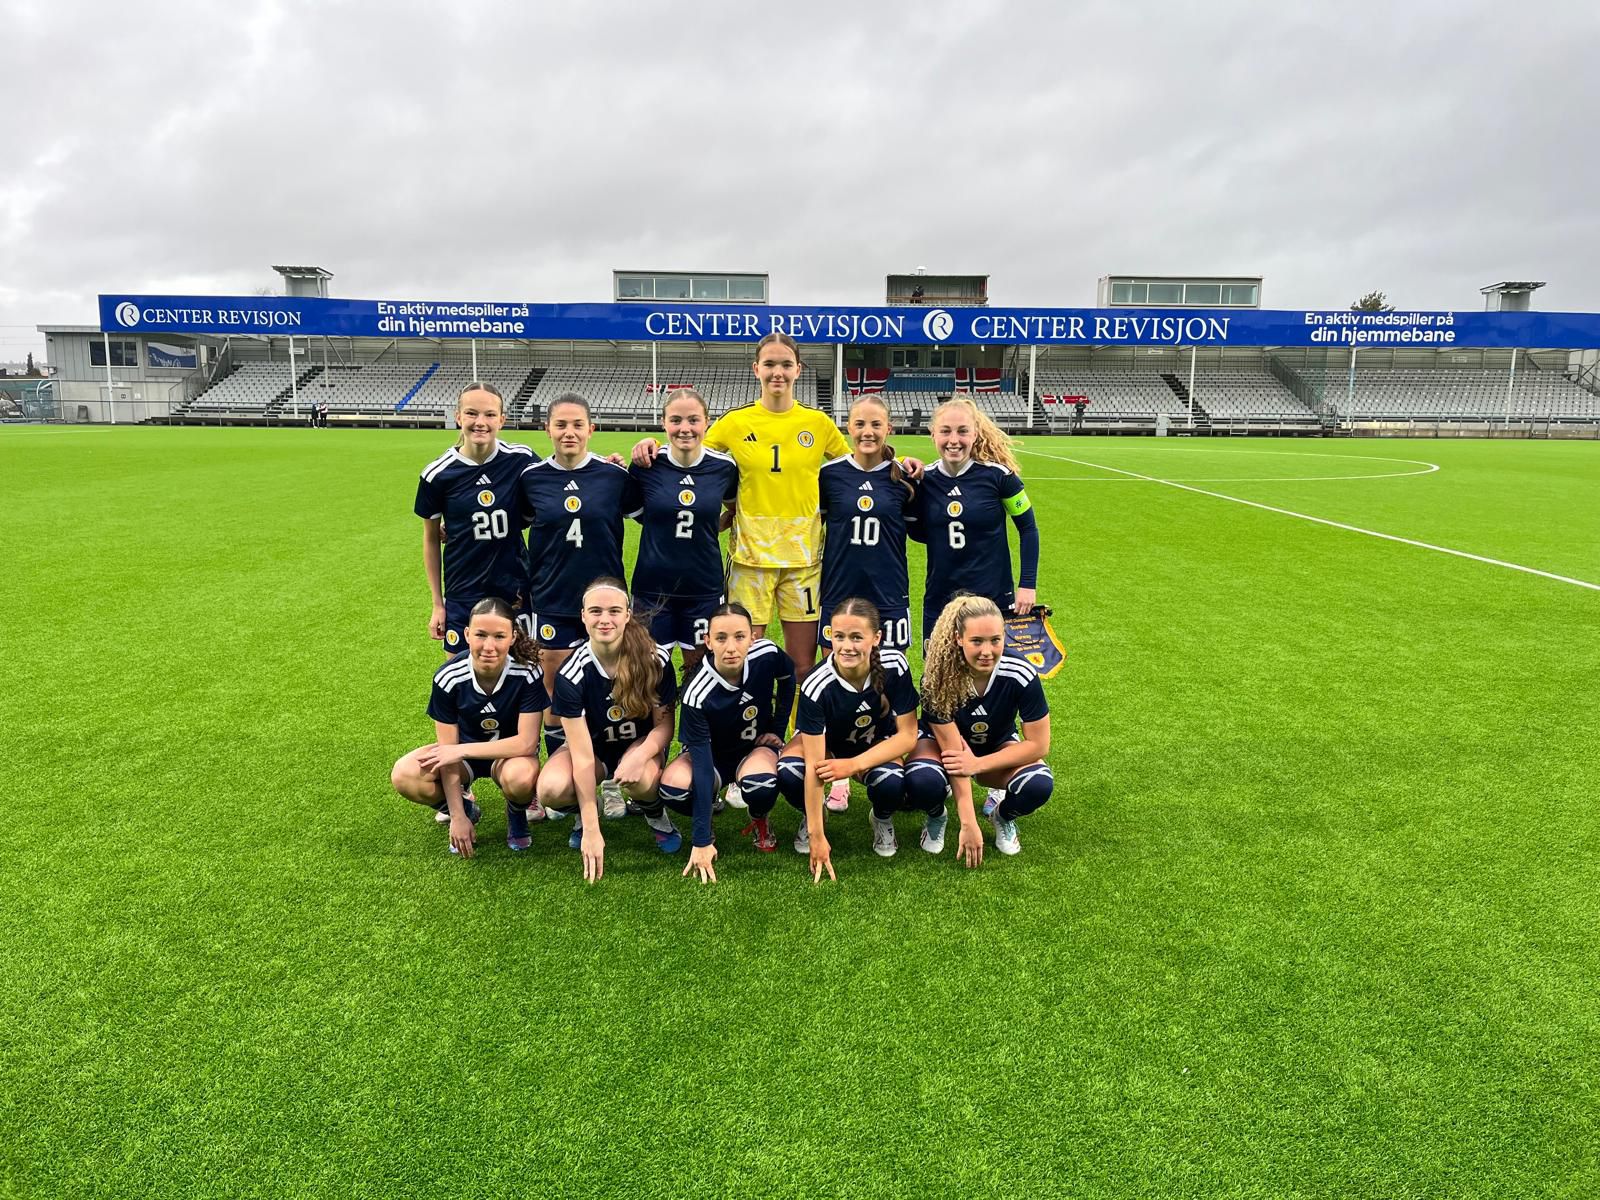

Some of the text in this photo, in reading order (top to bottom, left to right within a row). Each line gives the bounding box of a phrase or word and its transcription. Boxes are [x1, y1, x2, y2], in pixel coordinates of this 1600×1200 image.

[143, 308, 214, 324] CENTER
[218, 310, 301, 327] REVISJON
[377, 302, 529, 317] En aktiv medspiller på
[1304, 311, 1454, 327] En aktiv medspiller på
[377, 317, 525, 336] din hjemmebane
[645, 312, 762, 337] CENTER
[771, 314, 905, 342] REVISJON
[971, 315, 1231, 345] CENTER REVISJON
[1310, 327, 1456, 346] din hjemmebane
[770, 445, 782, 473] 1
[472, 509, 509, 541] 20
[566, 518, 584, 548] 4
[675, 510, 694, 539] 2
[850, 516, 881, 546] 10
[948, 521, 966, 549] 6
[803, 587, 816, 615] 1
[694, 619, 709, 645] 2
[883, 617, 909, 646] 10
[604, 721, 637, 742] 19
[845, 725, 876, 744] 14
[969, 733, 988, 744] 3
